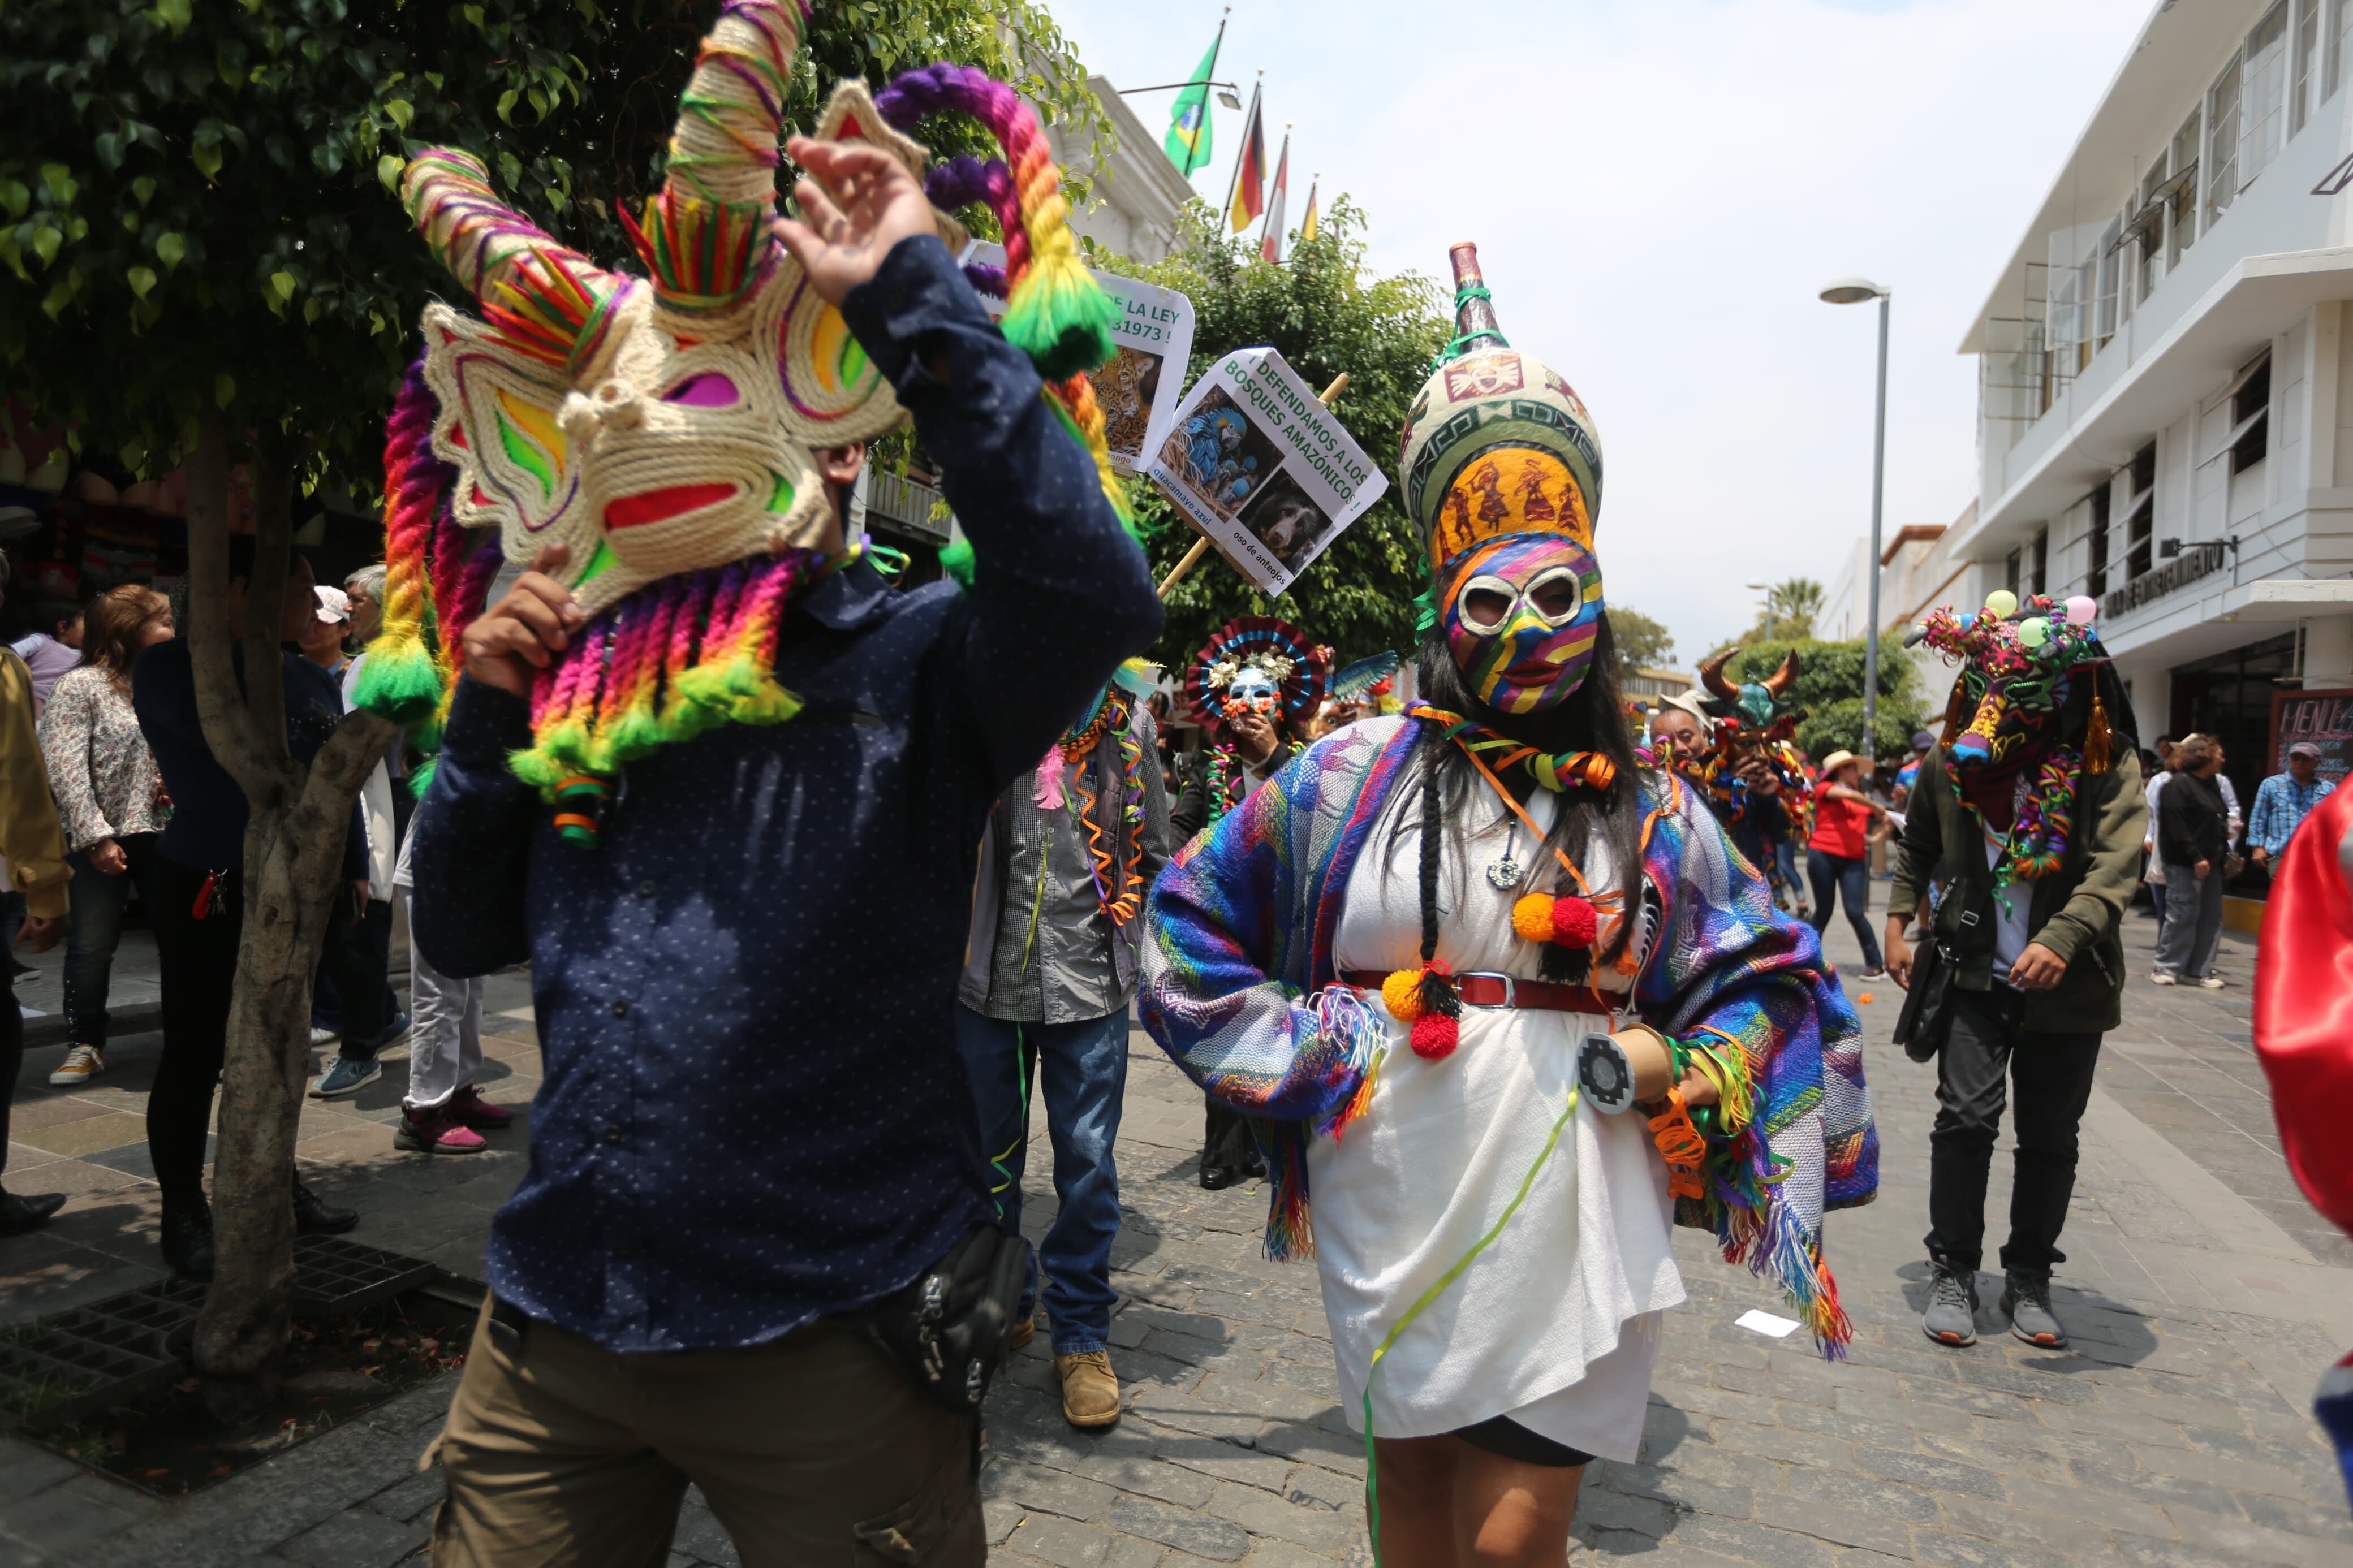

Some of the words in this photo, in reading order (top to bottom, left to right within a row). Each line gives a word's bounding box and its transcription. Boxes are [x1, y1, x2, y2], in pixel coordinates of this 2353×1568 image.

[1112, 319, 1161, 341] 31973
[1127, 300, 1146, 317] LA
[1151, 306, 1180, 325] LEY
[1225, 360, 1286, 426] BOSQUES
[1282, 425, 1355, 505] AMAZÓNICOS
[1256, 361, 1338, 452] DEFENDAMOS
[1334, 450, 1346, 463] A
[1343, 459, 1367, 486] LOS
[1194, 509, 1212, 525] azul
[1234, 532, 1247, 546] oso
[1247, 544, 1259, 555] de
[1256, 555, 1286, 585] anteojos
